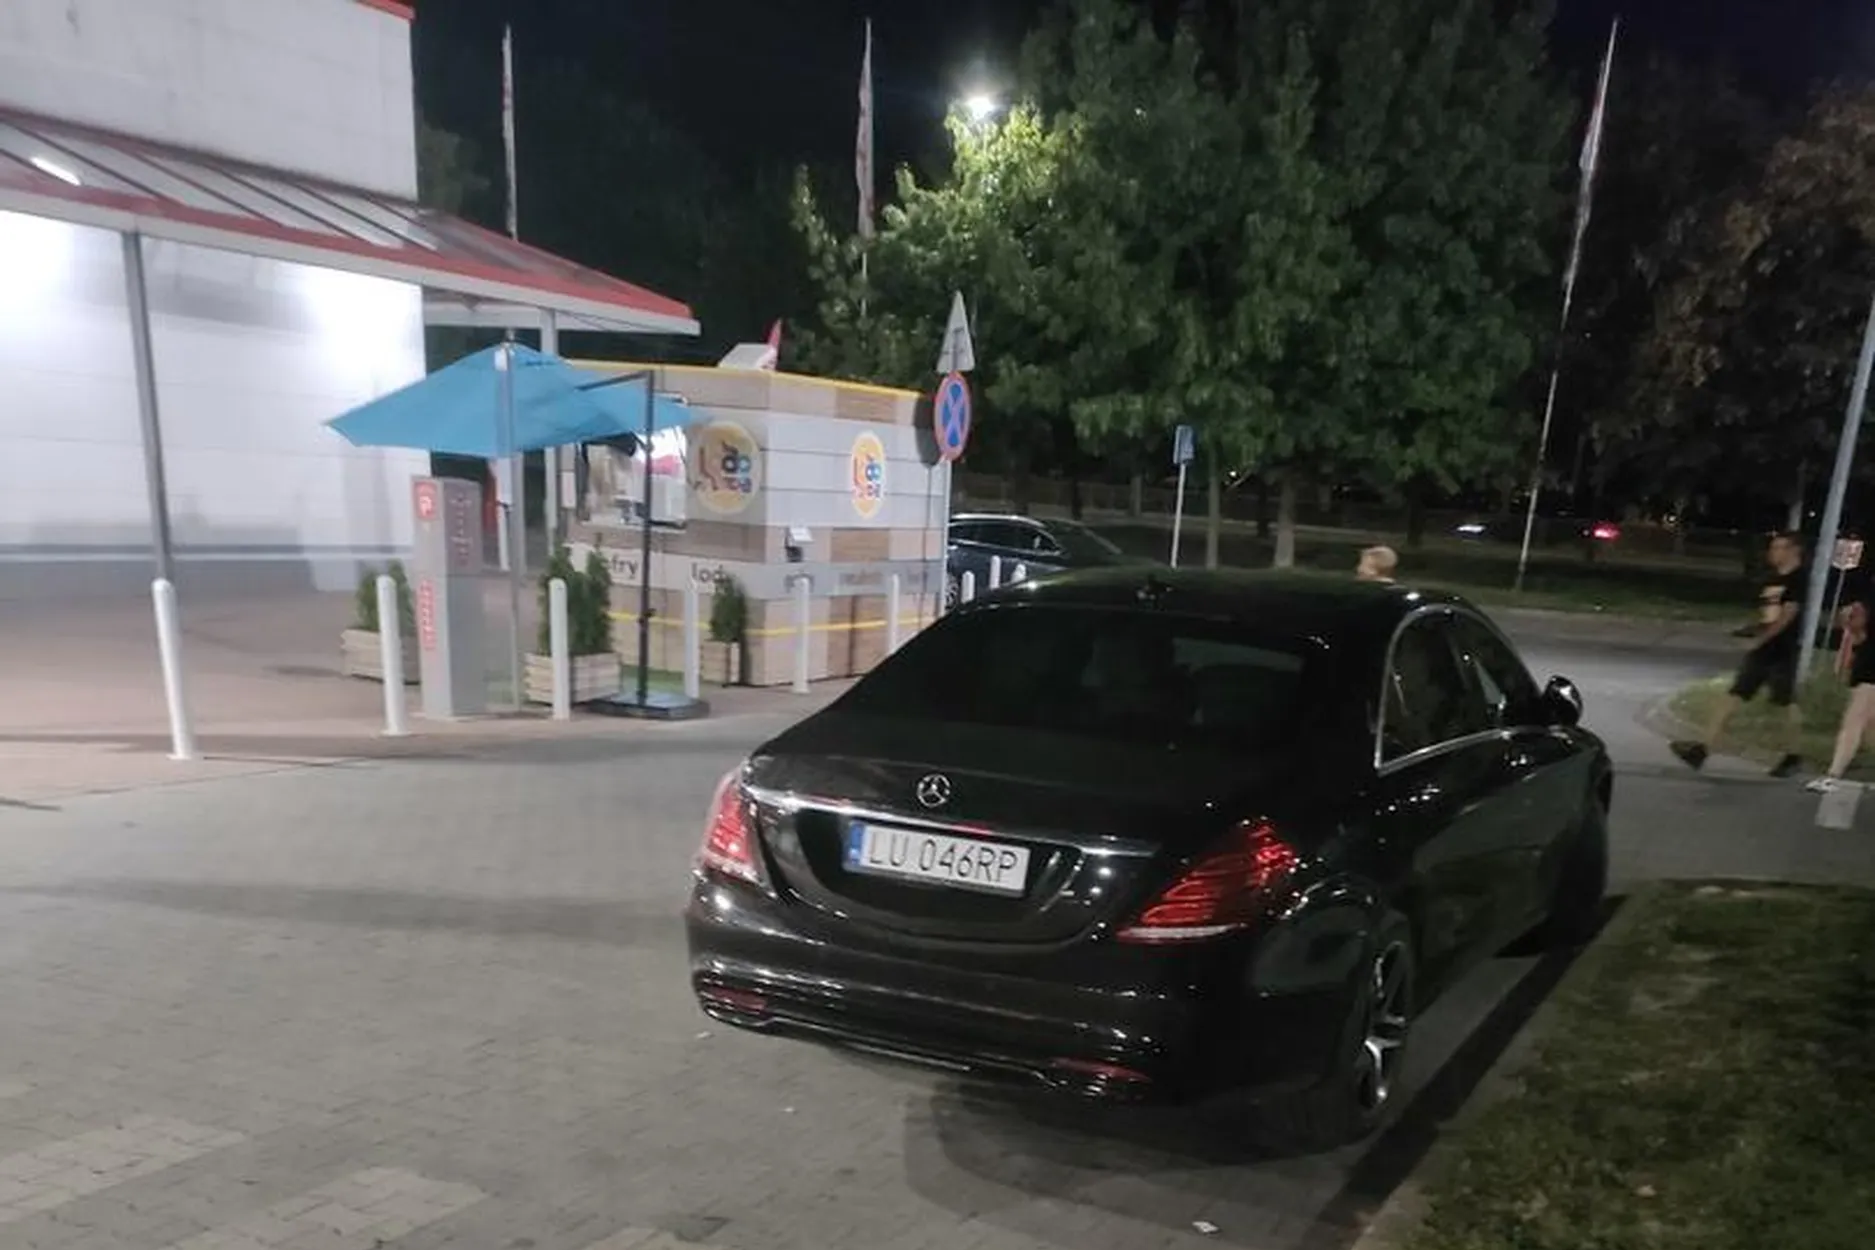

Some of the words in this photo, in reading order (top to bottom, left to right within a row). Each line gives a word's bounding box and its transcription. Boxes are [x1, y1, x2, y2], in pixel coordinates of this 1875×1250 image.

[608, 554, 638, 579] fry
[691, 564, 728, 584] lod
[869, 831, 909, 867] LU
[919, 839, 1018, 882] 046RP
